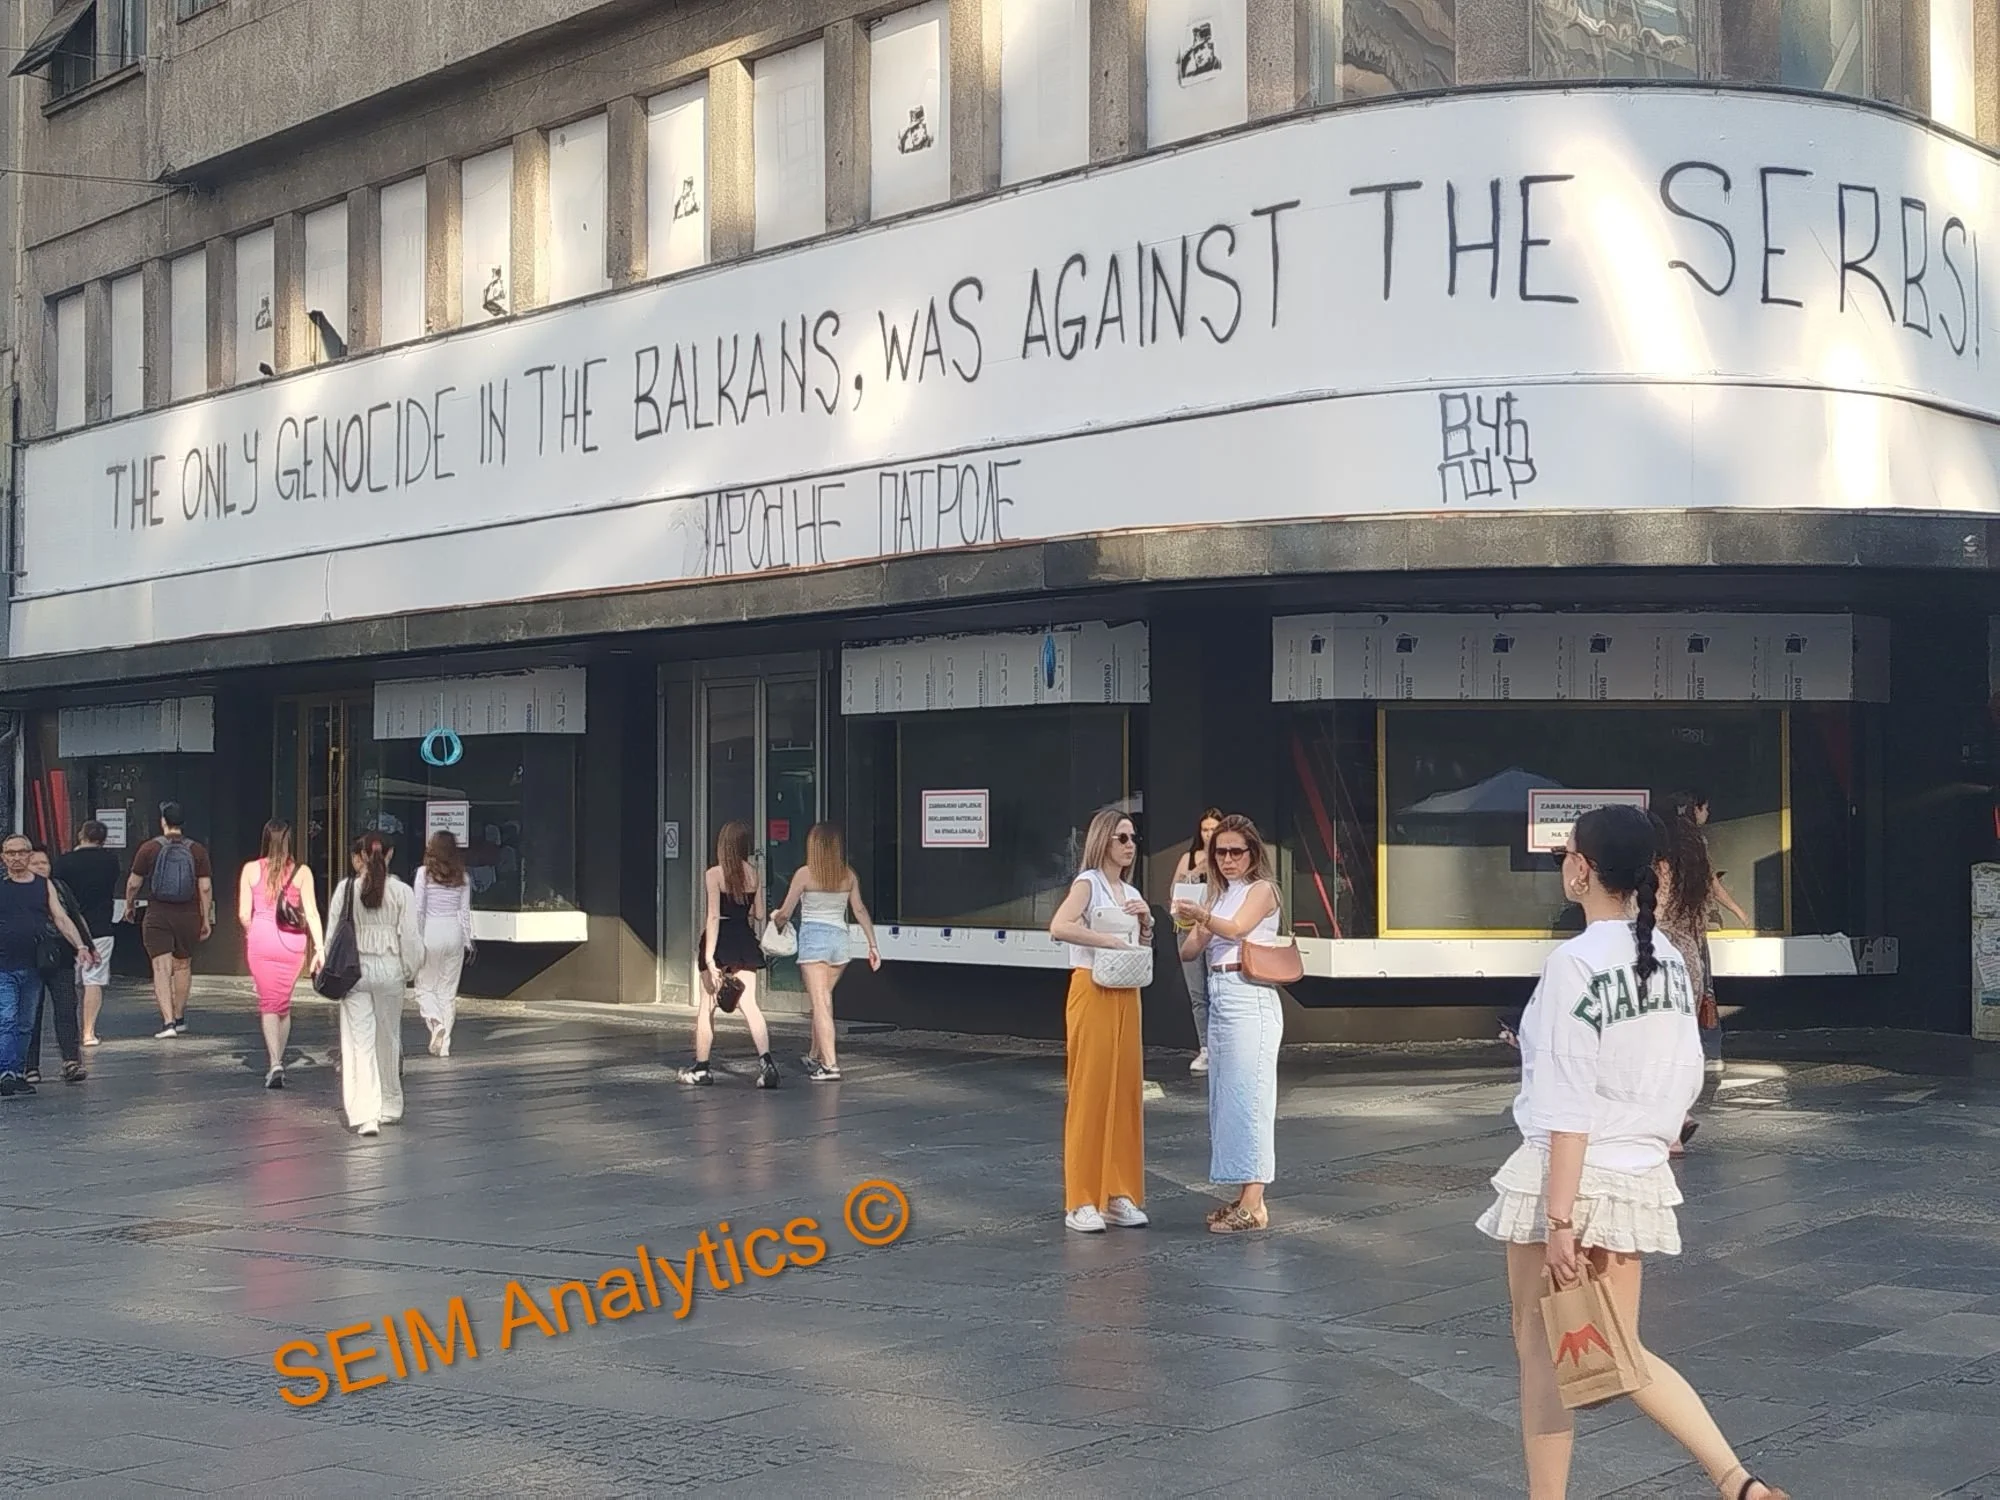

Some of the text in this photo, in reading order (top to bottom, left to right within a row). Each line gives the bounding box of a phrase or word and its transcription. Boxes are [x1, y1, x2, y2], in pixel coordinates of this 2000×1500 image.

[106, 453, 166, 530] THE
[181, 428, 259, 521] ONLY
[275, 386, 456, 500] GENOCIDE
[480, 377, 509, 466] IN
[524, 357, 607, 456] THE
[634, 310, 863, 441] BALKANS,
[878, 276, 984, 384] WAS
[1021, 200, 1300, 361] AGAINST
[1349, 174, 1579, 304] THE
[878, 459, 1022, 557] ПАТРОЛЕ
